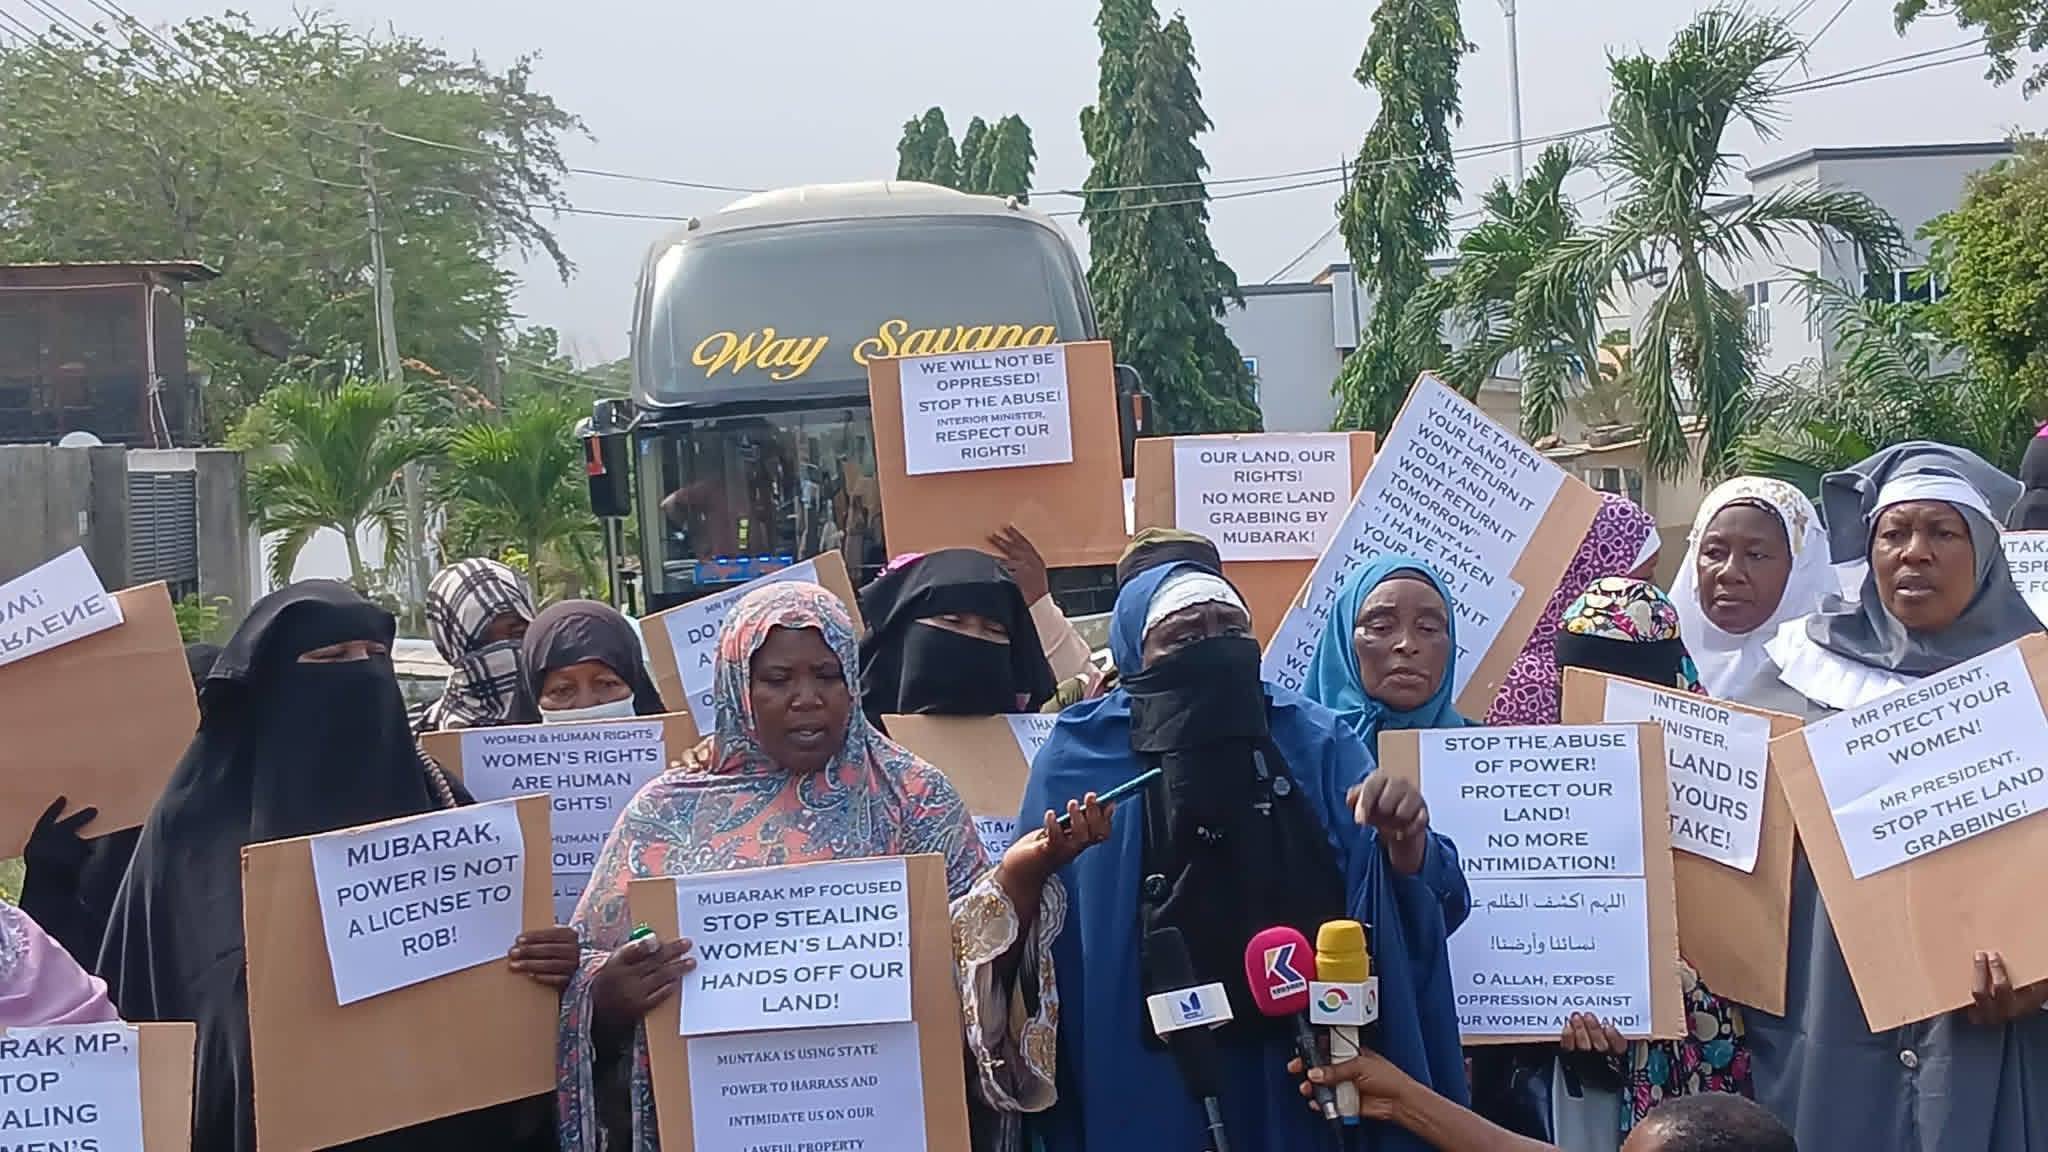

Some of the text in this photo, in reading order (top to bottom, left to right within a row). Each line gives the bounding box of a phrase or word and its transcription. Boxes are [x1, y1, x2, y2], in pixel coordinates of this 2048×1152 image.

[692, 328, 829, 380] Way
[920, 353, 1055, 375] WE WILL NOT BE
[937, 372, 1040, 391] OPPRESSED!
[919, 391, 1061, 412] STOP THE ABUSE!
[937, 415, 988, 426] INTERIOR
[936, 424, 1049, 443] RESPECT OUR
[1428, 407, 1517, 478] YOUR LAND, I
[1451, 404, 1492, 438] HAVE
[1493, 431, 1540, 472] TAKEN
[961, 444, 1026, 459] RIGHTS!
[1200, 450, 1335, 464] OUR LAND, OUR
[1234, 471, 1302, 483] RIGHTS!
[1408, 440, 1496, 508] TODAY AND I
[1418, 424, 1536, 513] WONT RETURN IT
[1202, 491, 1335, 505] NO MORE LAND
[1379, 488, 1413, 517] HON
[1400, 456, 1517, 543] WONT RETURN IT
[1209, 511, 1328, 525] GRABBING BY
[1223, 531, 1315, 544] MUBARAK!
[1363, 522, 1407, 556] YOUR
[1460, 583, 1468, 593] I
[1390, 517, 1438, 552] HAVE
[1440, 545, 1494, 586] TAKEN
[1471, 611, 1489, 627] IT
[688, 624, 715, 645] DO
[1653, 692, 1730, 725] INTERIOR
[1852, 667, 1990, 729] MR PRESIDENT,
[1846, 681, 2012, 756] PROTECT YOUR
[483, 728, 653, 745] WOMEN & HUMAN RIGHTS
[1444, 733, 1626, 752] STOP THE ABUSE
[1888, 719, 1983, 765] WOMEN!
[482, 748, 657, 768] WOMEN'S RIGHTS
[1475, 757, 1596, 773] OF POWER!
[1669, 749, 1759, 790] LAND IS
[1879, 750, 2020, 811] MR PRESIDENT,
[512, 773, 631, 790] ARE HUMAN
[1461, 783, 1613, 799] PROTECT OUR
[1671, 781, 1749, 821] YOURS
[1872, 767, 2044, 840] STOP THE LAND
[1504, 807, 1570, 822] LAND!
[1668, 814, 1731, 850] TAKE!
[1904, 799, 2028, 856] GRABBING!
[347, 822, 500, 867] MUBARAK,
[1488, 832, 1588, 848] NO MORE
[1462, 855, 1616, 872] INTIMIDATION!
[337, 855, 518, 907] POWER IS NOT
[697, 880, 902, 906] MUBARAK MP FOCUSED
[349, 885, 511, 938] A LICENSE TO
[703, 904, 898, 933] STOP STEALING
[402, 926, 458, 957] ROB!
[699, 931, 903, 961] WOMEN'S LAND!
[701, 962, 903, 991] HANDS OFF OUR
[1473, 973, 1486, 985] O
[1553, 975, 1615, 985] EXPOSE
[762, 993, 839, 1013] LAND!
[1457, 995, 1632, 1006] OPPRESSION AGAINST
[1487, 1015, 1548, 1026] WOMEN
[1601, 1014, 1640, 1026] AND!
[0, 1033, 128, 1059] RAK MP,
[717, 1043, 878, 1065] MUNTAKA IS USING STATE
[0, 1072, 60, 1094] TOP
[721, 1075, 878, 1097] POWER TO HARRASS AND
[0, 1104, 98, 1130] ALING
[729, 1107, 874, 1127] INTIMIDATE US ON OUR
